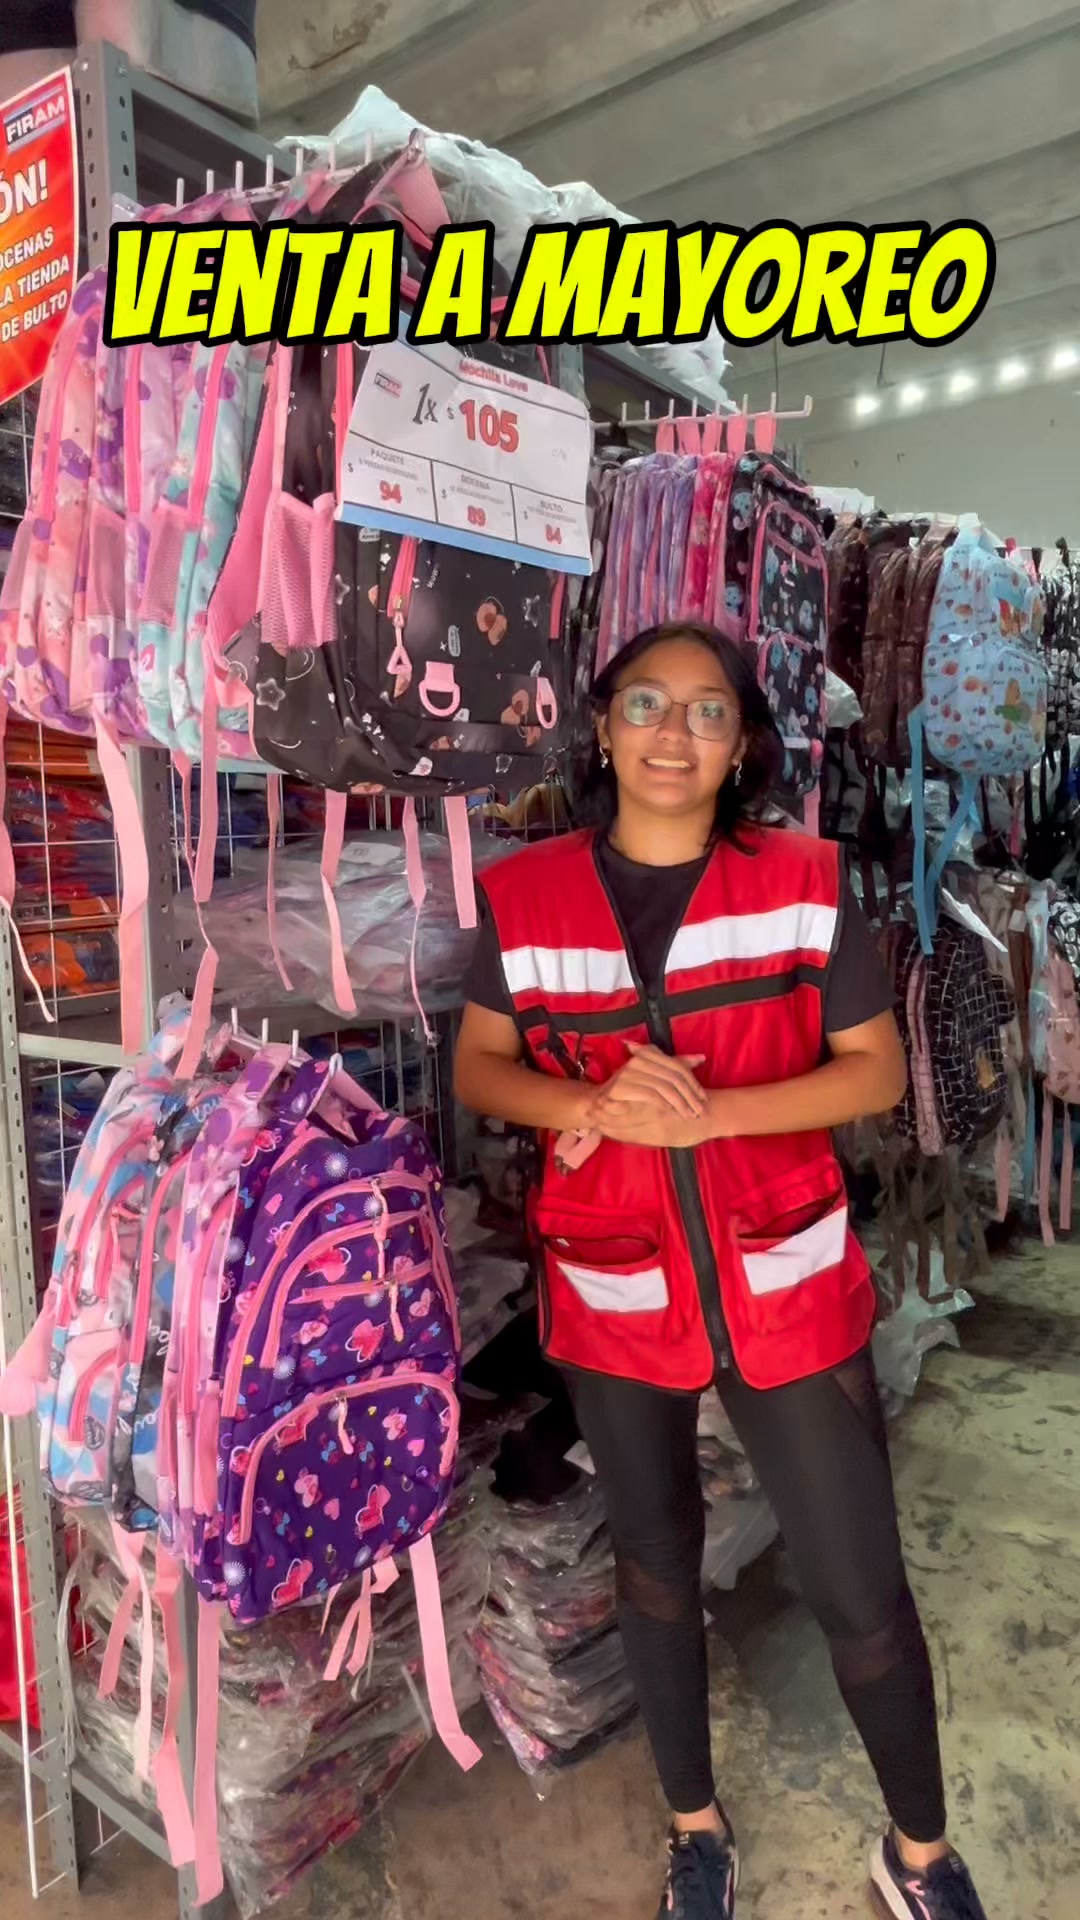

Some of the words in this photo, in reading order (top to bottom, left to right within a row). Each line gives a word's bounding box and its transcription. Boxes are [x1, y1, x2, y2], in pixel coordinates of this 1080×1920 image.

[6, 96, 65, 143] FIRAM
[0, 226, 54, 271] CENAS
[17, 254, 69, 297] TIENDA
[2, 317, 20, 341] DE
[24, 289, 67, 331] BULTO
[459, 399, 519, 453] 105
[380, 479, 403, 504] 94
